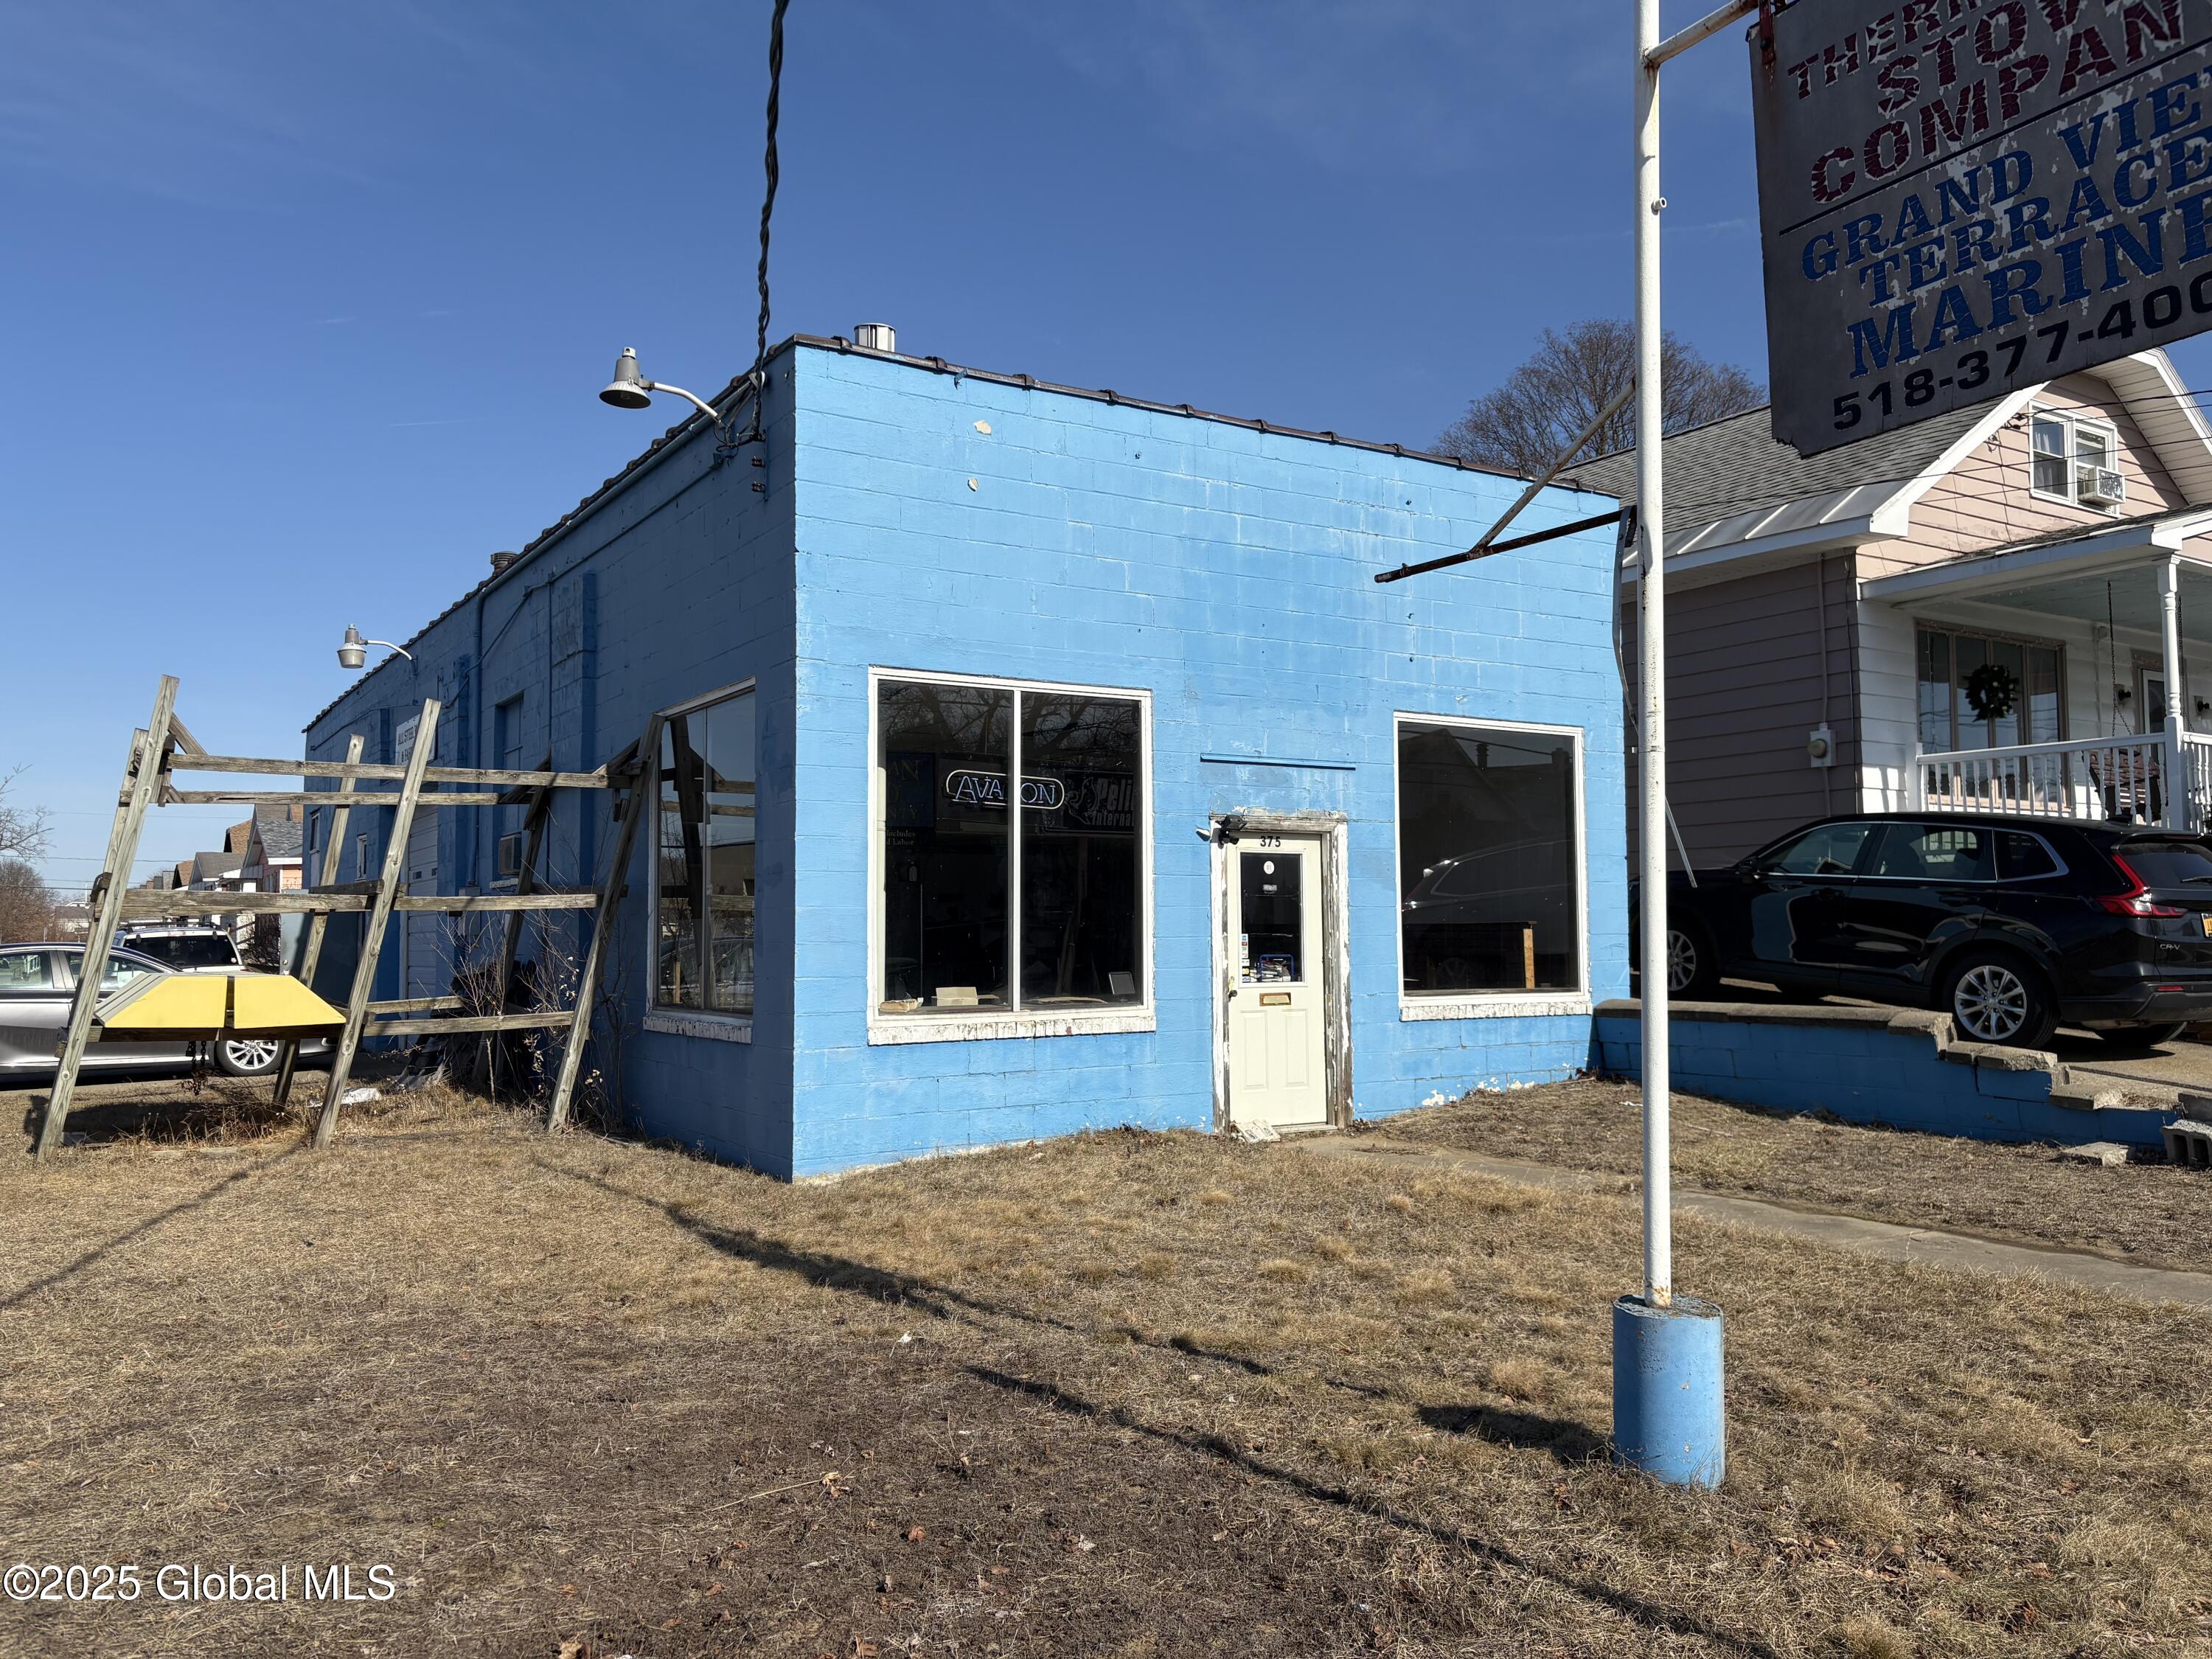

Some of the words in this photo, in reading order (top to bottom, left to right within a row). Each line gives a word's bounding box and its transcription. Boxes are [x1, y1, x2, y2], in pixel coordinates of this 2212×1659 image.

[1811, 0, 2183, 204] COMPAN
[1877, 0, 2121, 115] STOV
[1801, 150, 2034, 281] GRAND
[2057, 65, 2212, 170] VIE
[1859, 128, 2212, 307] TERRACE
[1846, 190, 2212, 379] MARINE
[951, 775, 1056, 804] AVAON
[1096, 778, 1133, 811] Peli
[1260, 835, 1281, 847] 375
